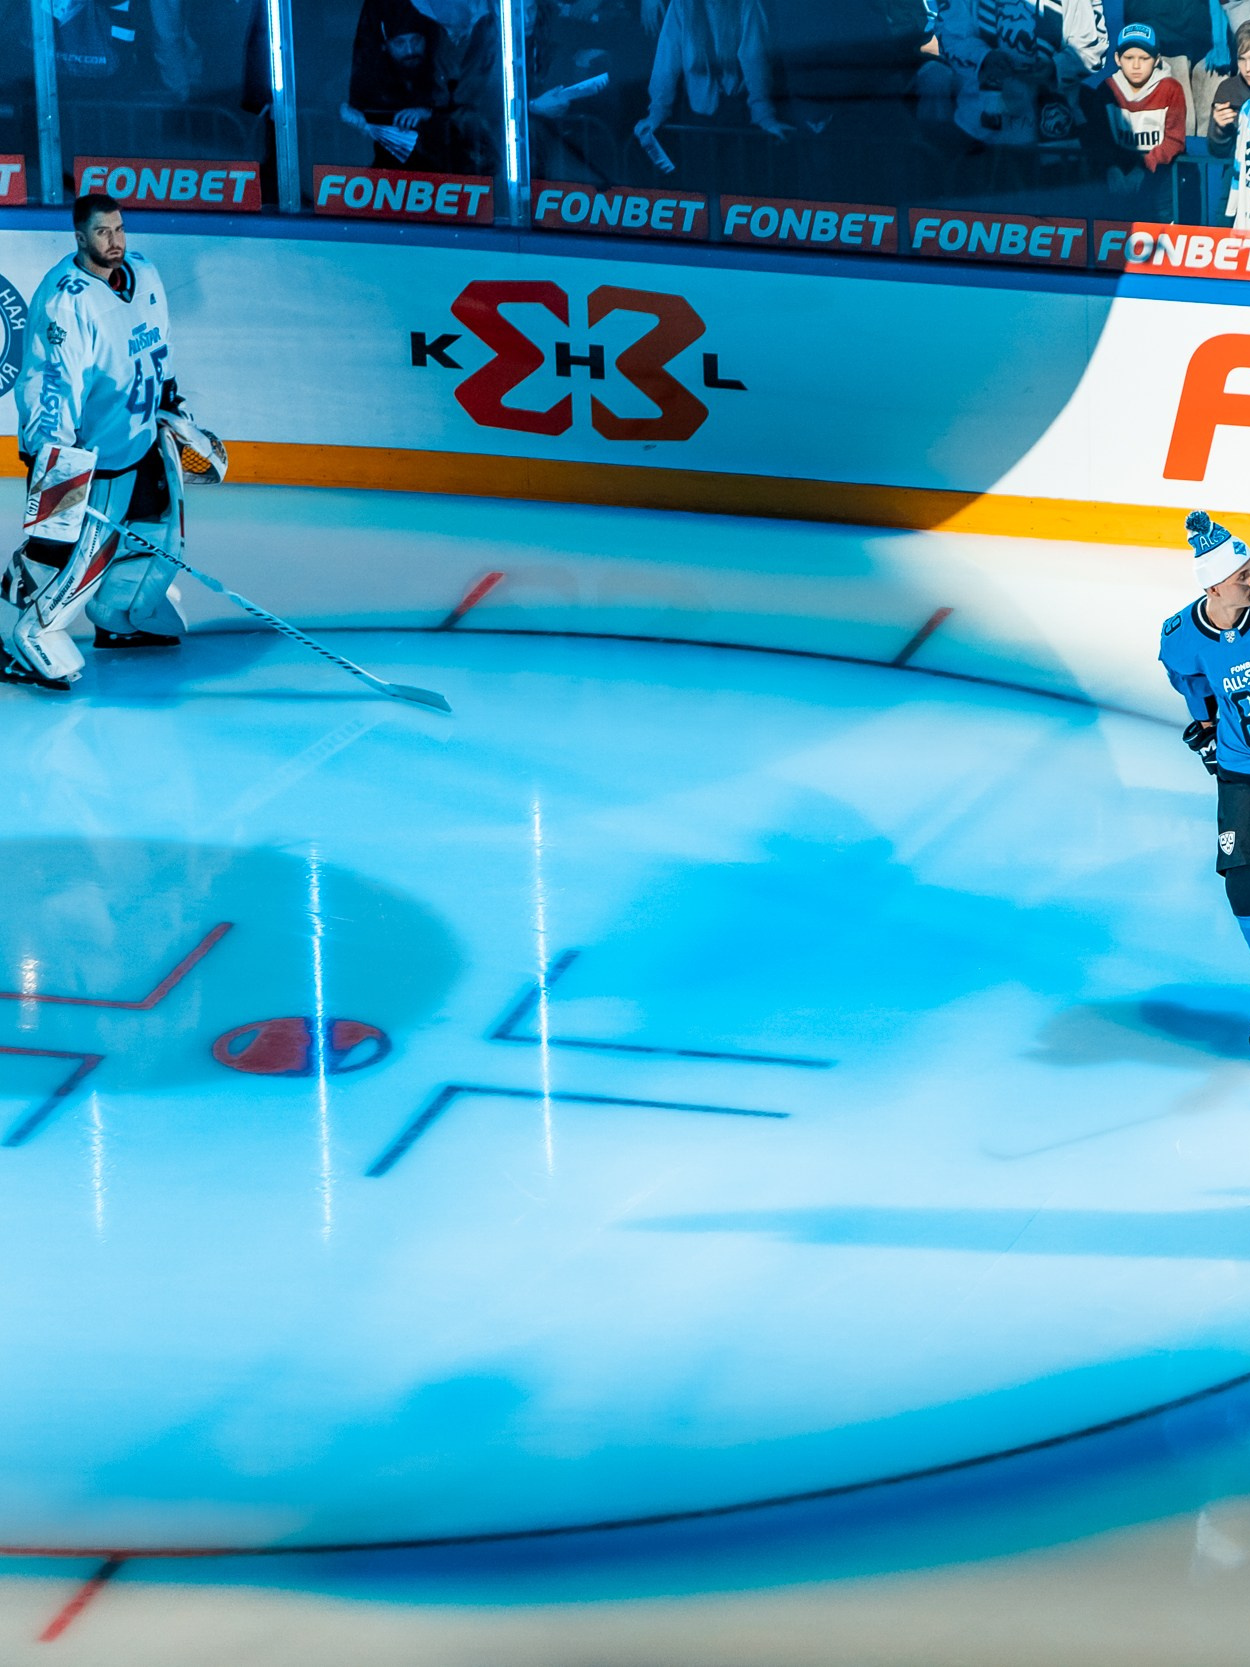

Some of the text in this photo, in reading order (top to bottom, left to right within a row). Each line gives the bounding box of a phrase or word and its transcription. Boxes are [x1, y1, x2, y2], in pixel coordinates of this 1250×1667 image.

[79, 165, 256, 203] FONBET
[317, 174, 490, 217] FONBET
[534, 189, 705, 232] FONBET
[723, 204, 894, 246] FONBET
[911, 217, 1084, 260] FONBET
